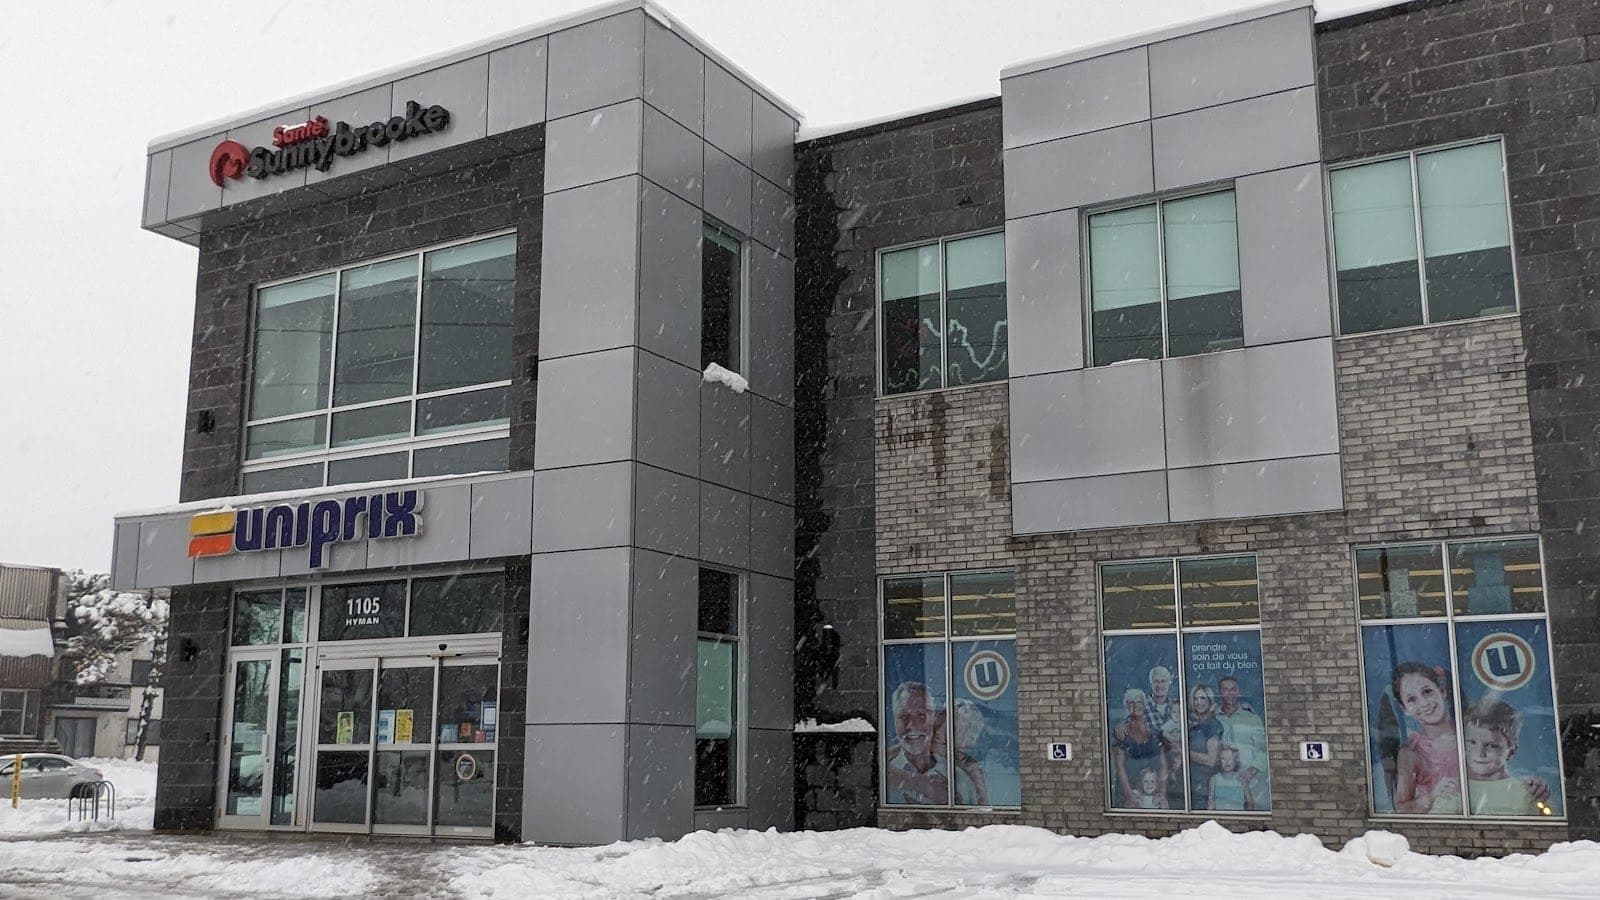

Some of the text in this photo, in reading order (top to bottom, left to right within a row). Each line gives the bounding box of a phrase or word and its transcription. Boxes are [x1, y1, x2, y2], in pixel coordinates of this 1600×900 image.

[347, 597, 380, 615] 1105
[345, 617, 380, 626] HYMAN
[1191, 643, 1227, 653] prendre
[1192, 652, 1248, 661] soin de vous
[1237, 660, 1258, 669] bien
